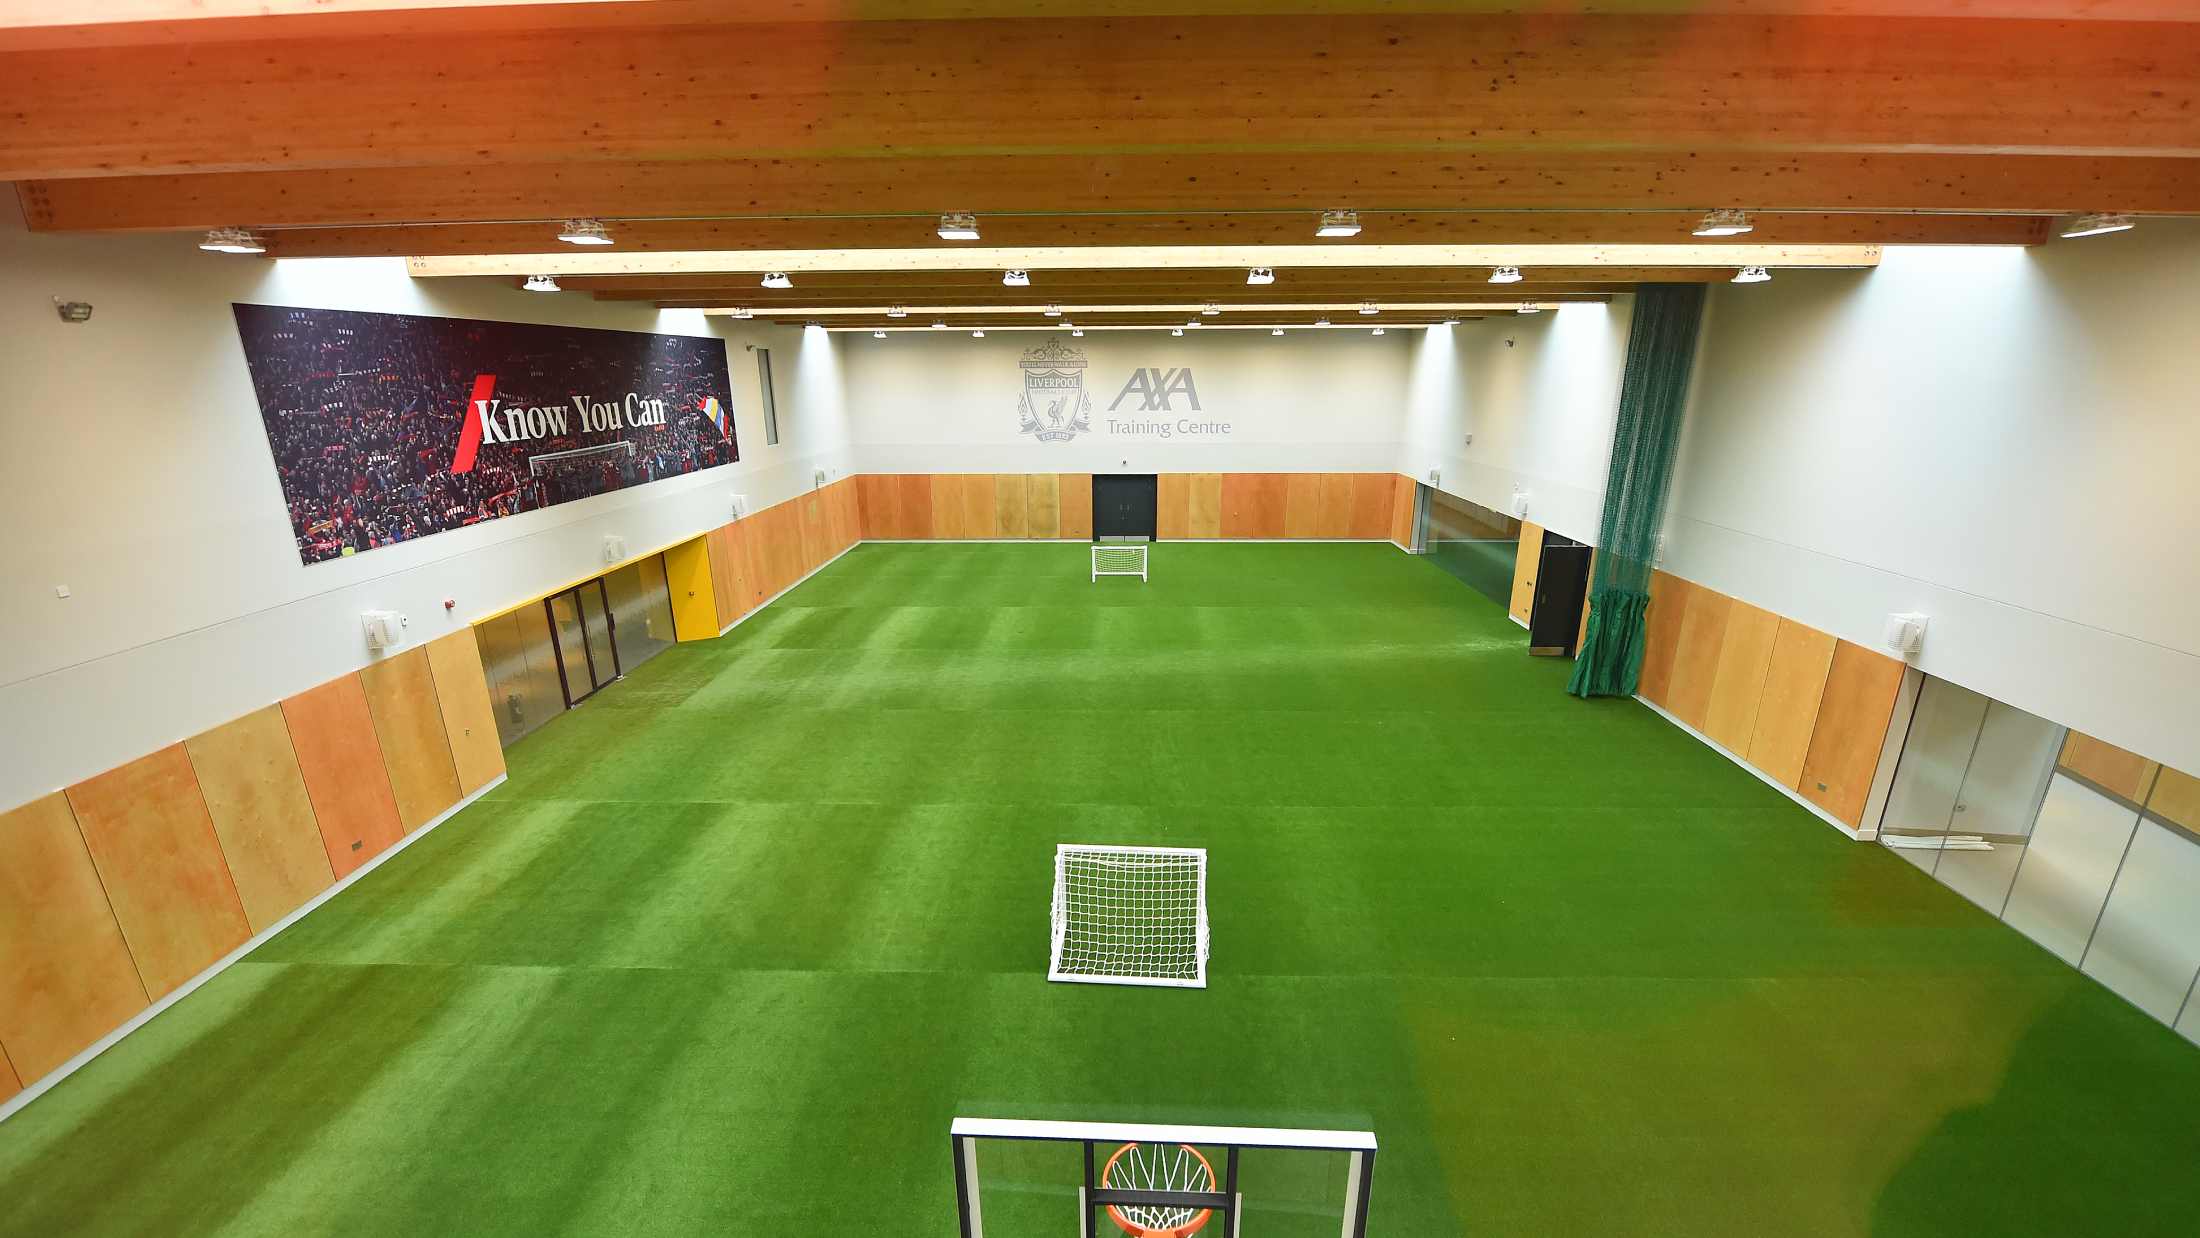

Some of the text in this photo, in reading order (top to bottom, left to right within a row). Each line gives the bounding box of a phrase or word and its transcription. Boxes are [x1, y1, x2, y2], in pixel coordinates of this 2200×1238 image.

[1029, 377, 1079, 388] LIVERPOOL
[1107, 367, 1201, 411] AXA
[474, 392, 667, 445] Know You Can
[1106, 418, 1232, 438] Training Centre
